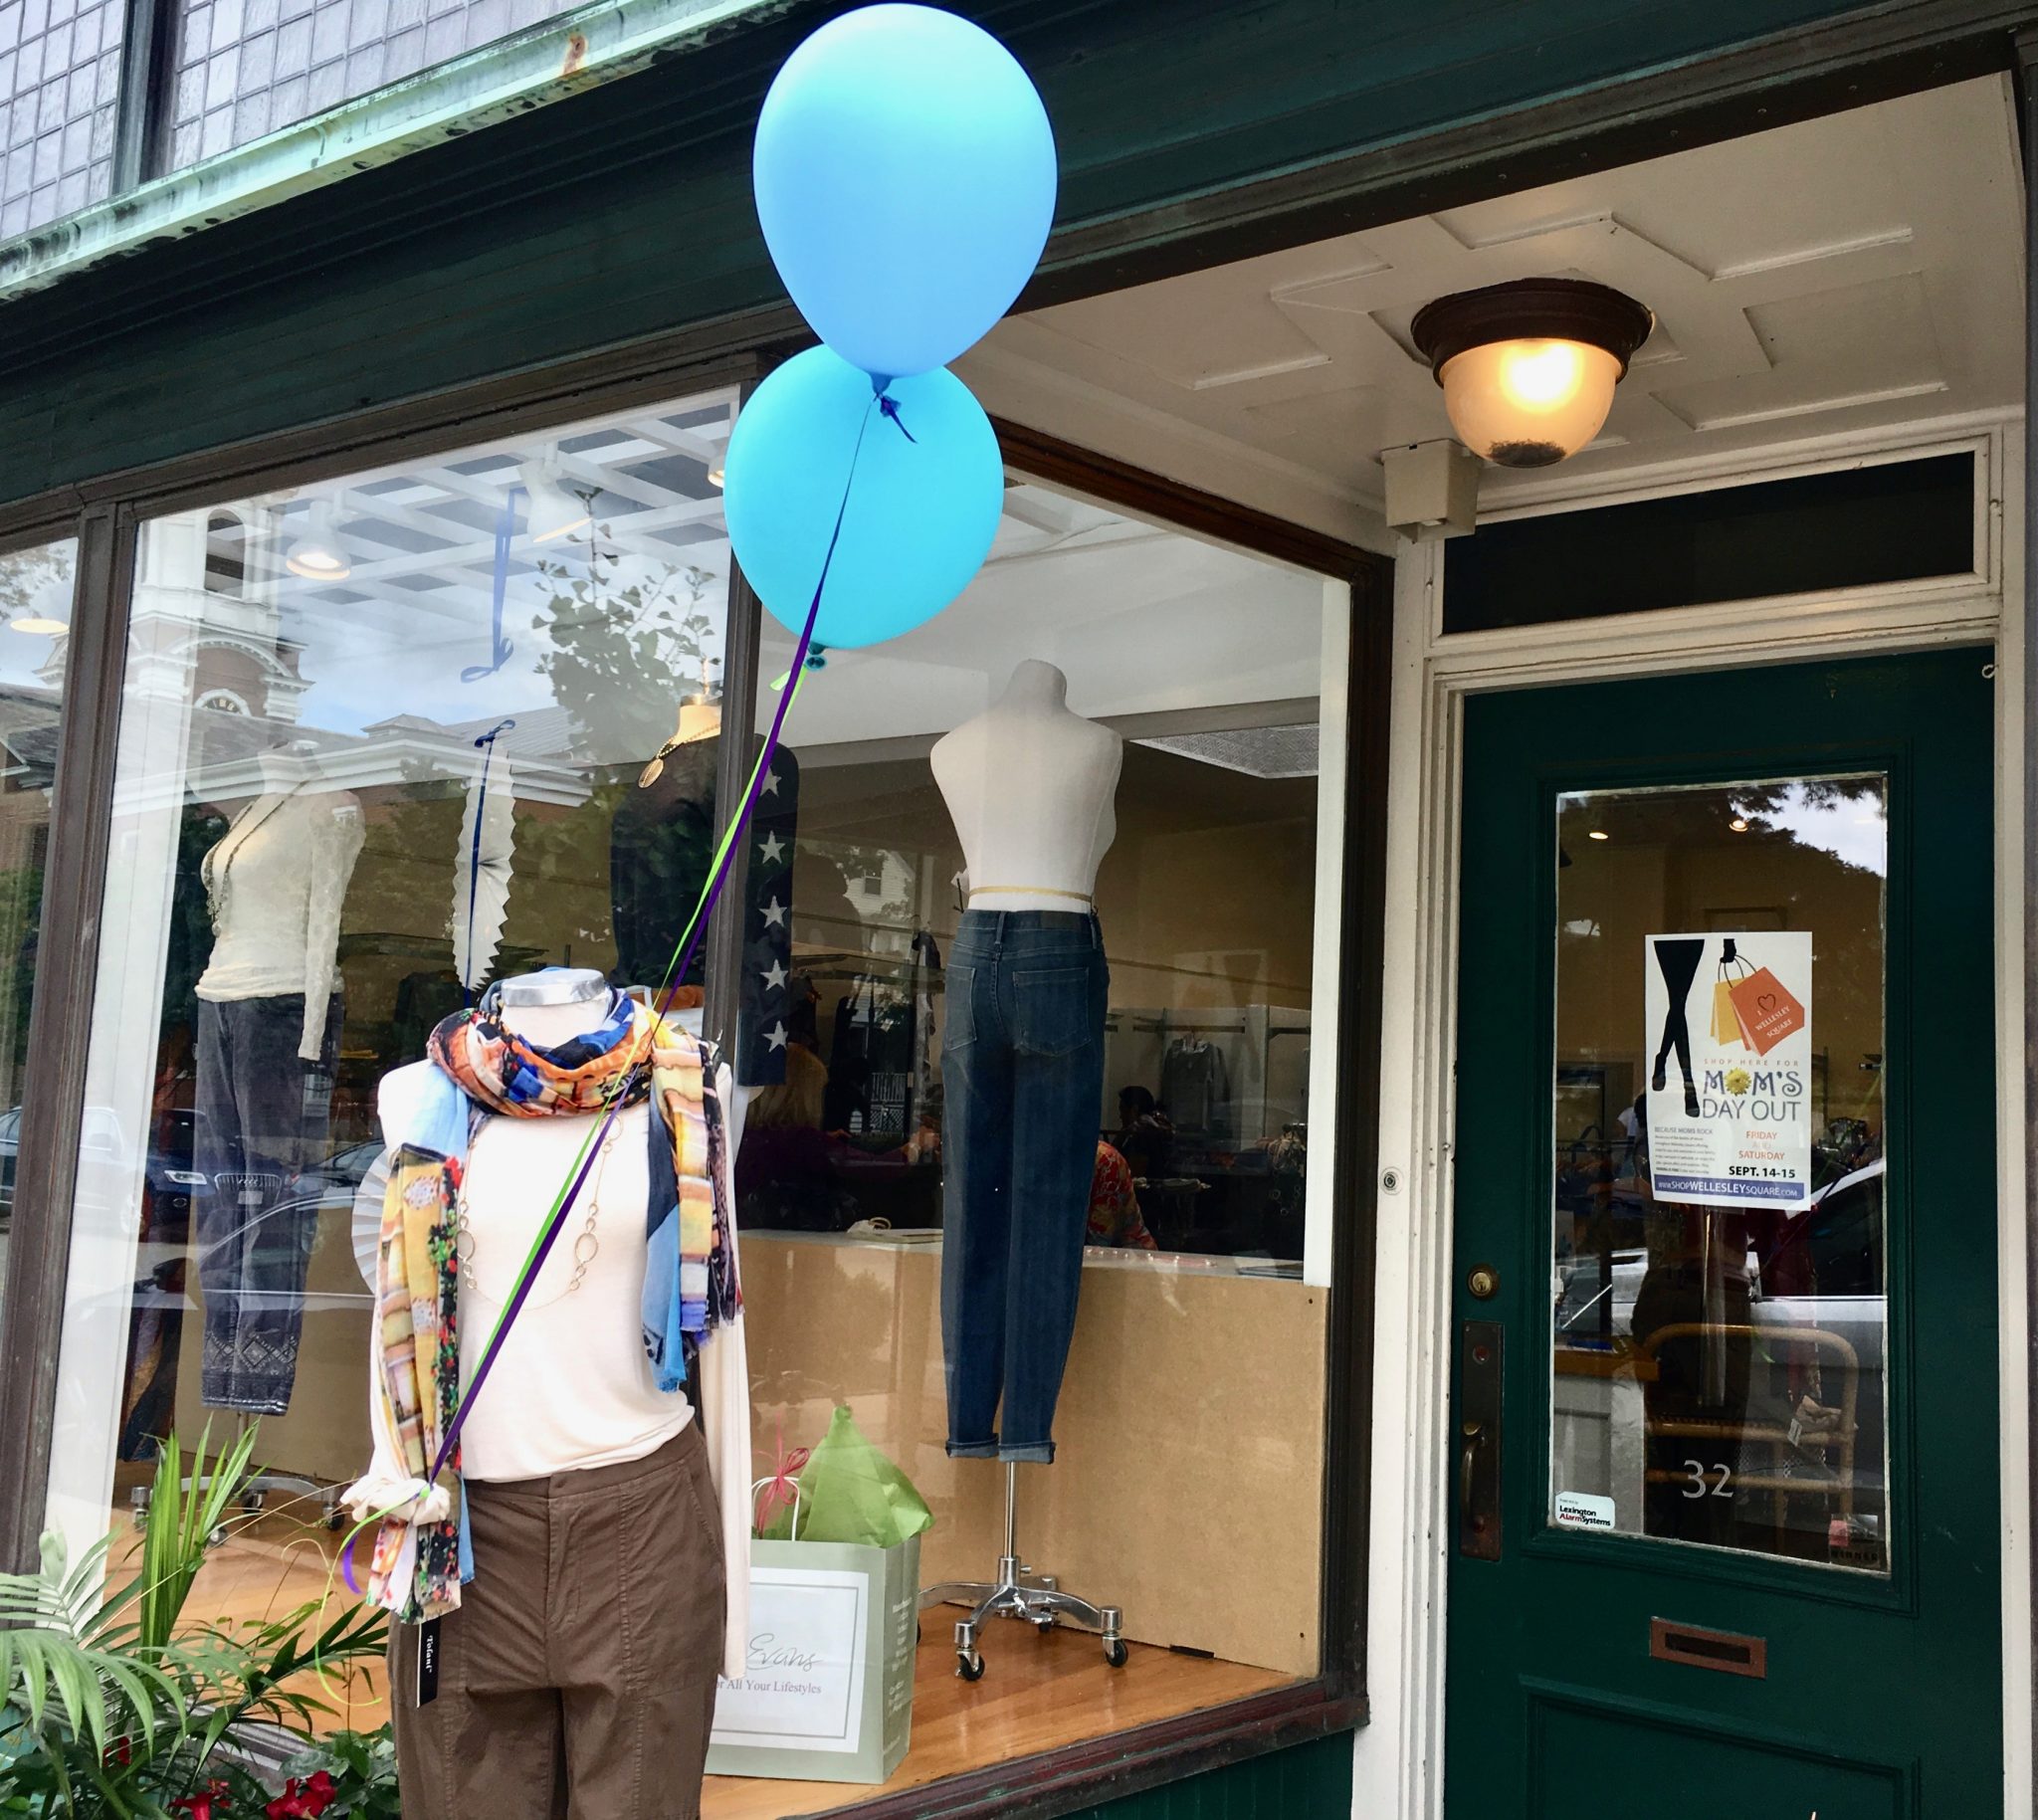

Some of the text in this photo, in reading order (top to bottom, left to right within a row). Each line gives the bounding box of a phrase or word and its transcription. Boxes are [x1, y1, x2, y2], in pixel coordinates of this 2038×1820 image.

[1754, 1005, 1790, 1031] WELLESLEY
[1766, 1018, 1793, 1038] SQUARE
[1703, 1099, 1801, 1121] DAY OUT
[1745, 1130, 1777, 1139] FRIDAY
[1738, 1150, 1785, 1160] SATURDAY
[1729, 1165, 1796, 1179] SEPT. 14-15
[1682, 1459, 1734, 1499] 32
[1559, 1505, 1597, 1517] Lexington
[746, 1633, 823, 1672] Evans
[726, 1679, 743, 1690] All
[746, 1680, 770, 1692] Your
[773, 1681, 822, 1696] Lifestyles
